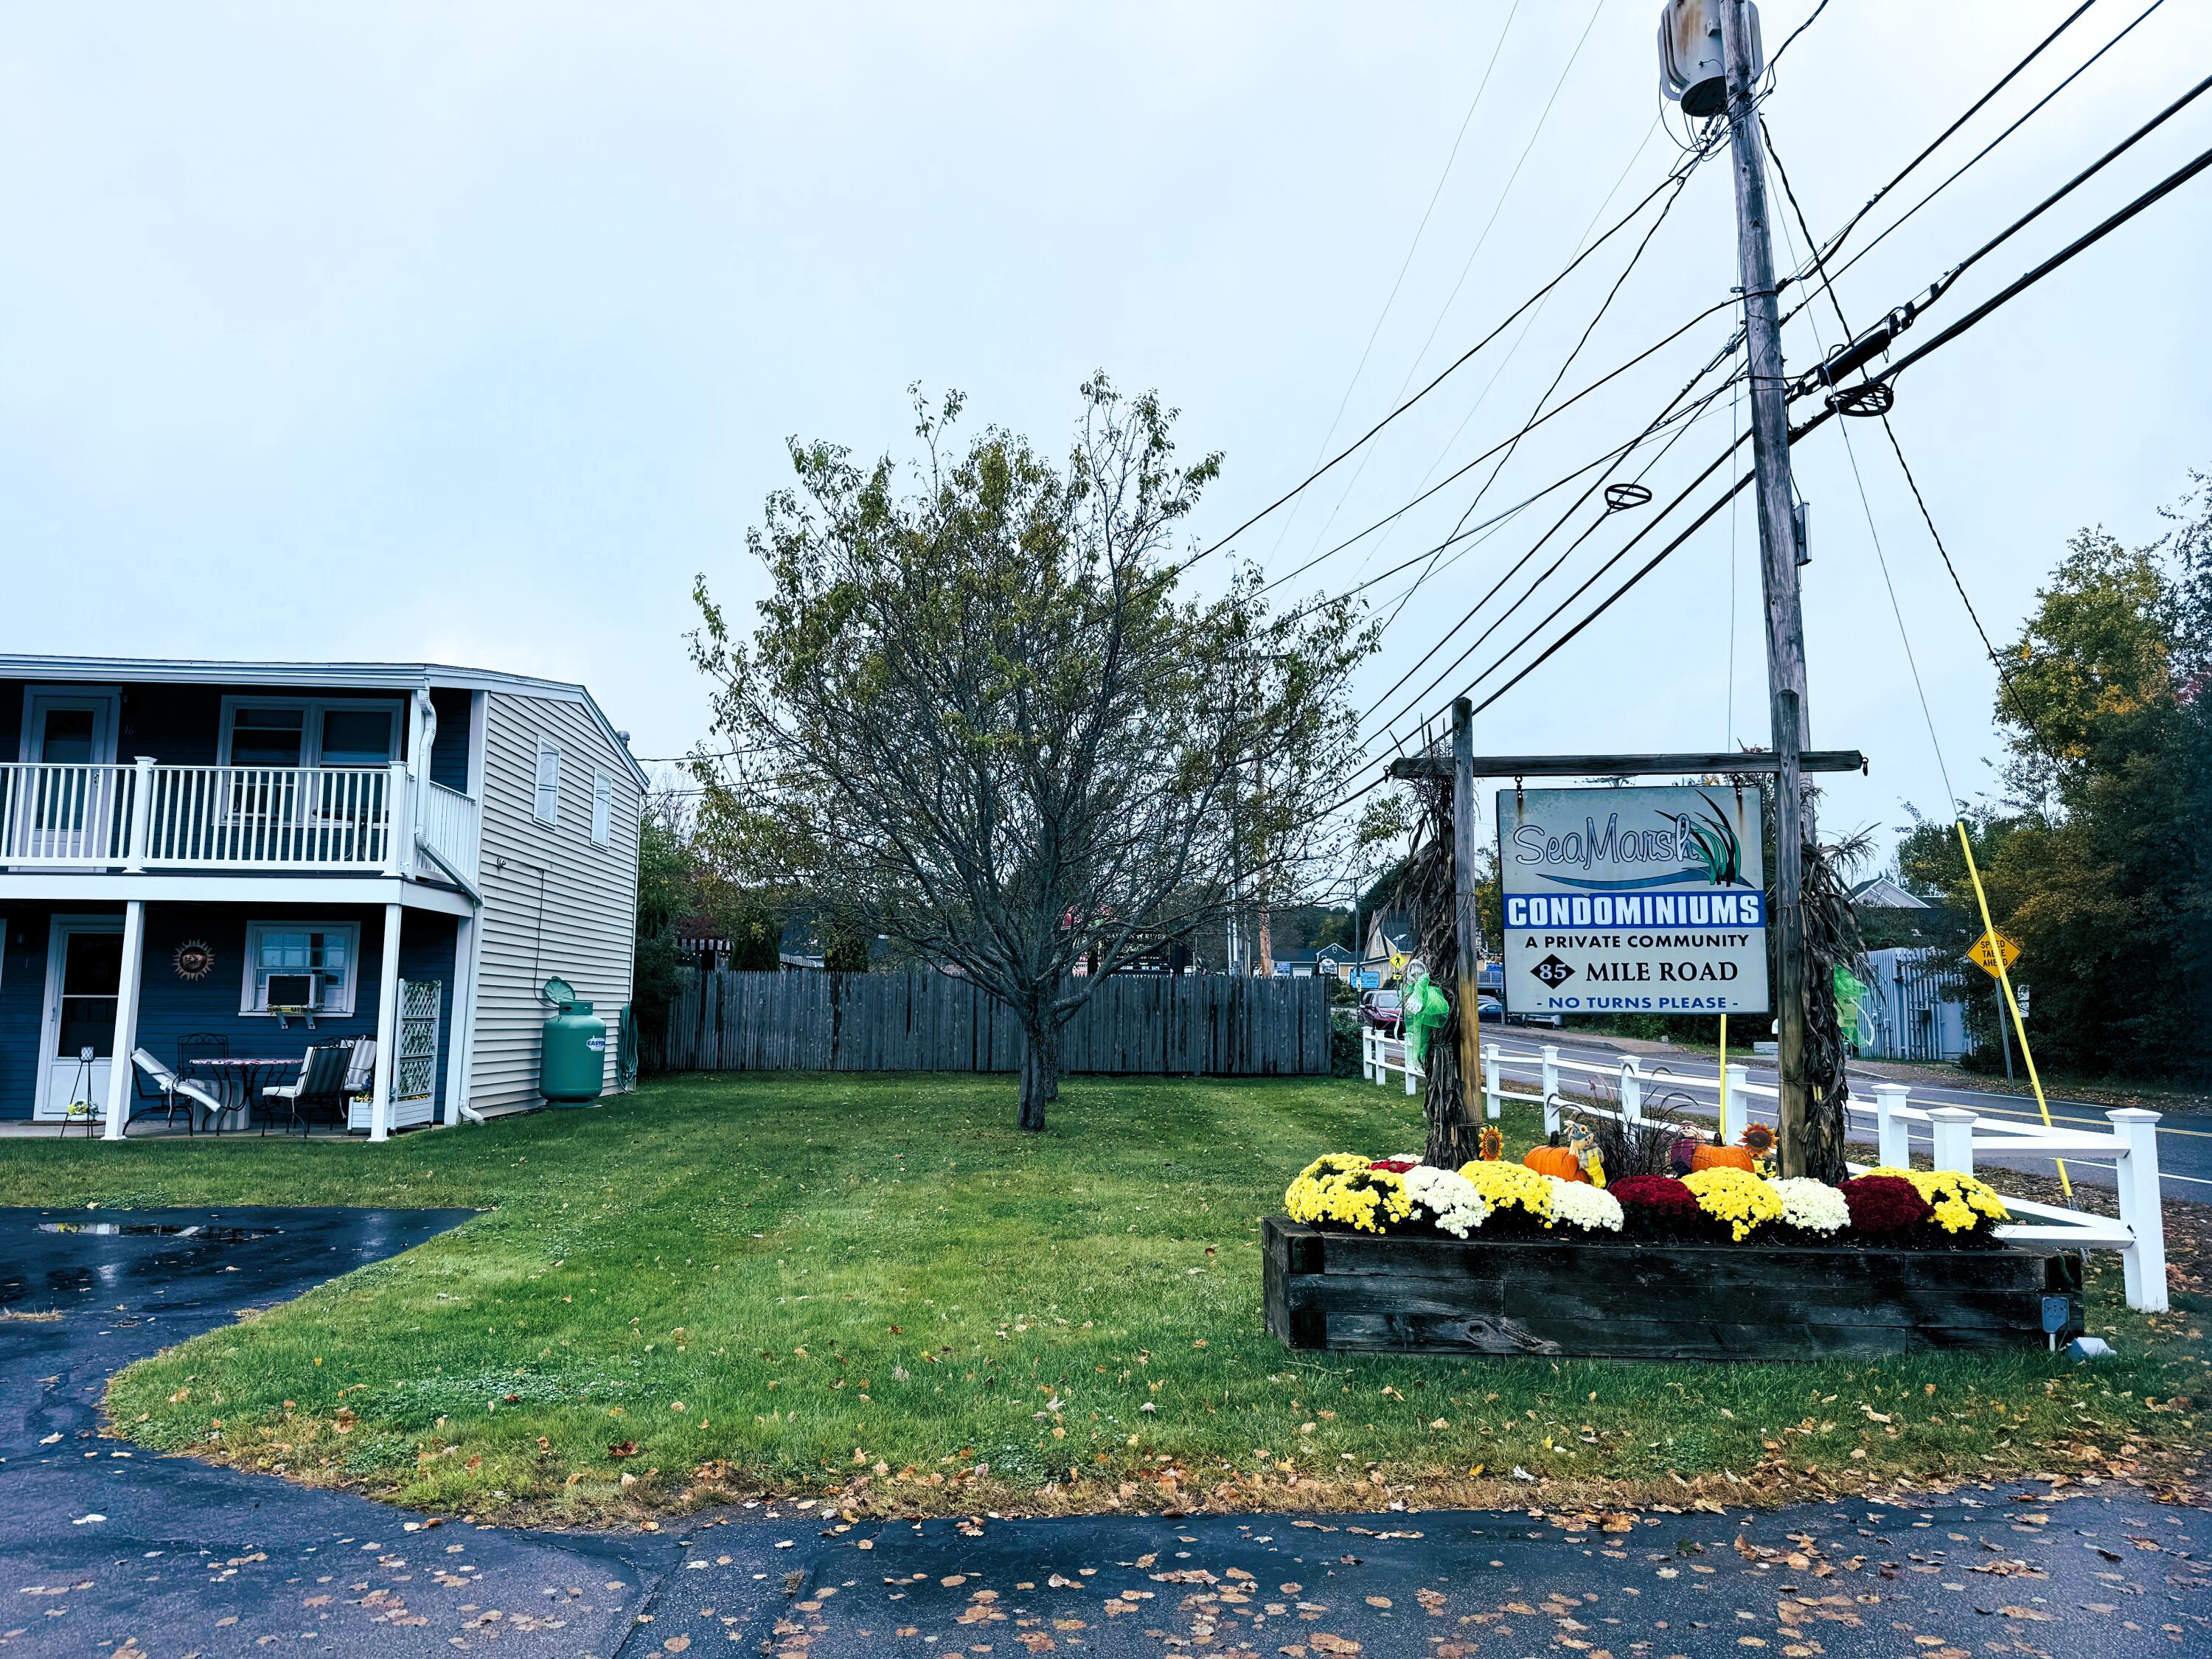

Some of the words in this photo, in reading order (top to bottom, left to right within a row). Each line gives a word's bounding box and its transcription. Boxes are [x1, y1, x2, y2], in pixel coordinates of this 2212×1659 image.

[1508, 894, 1759, 926] CONDOMINIUMS
[1525, 936, 1538, 948] A
[1545, 936, 1621, 948] PRIVATE
[1627, 934, 1750, 947] COMMUNITY
[1980, 940, 2005, 948] SPED
[1983, 959, 2008, 967] AHED
[1539, 964, 1567, 980] 85
[1585, 962, 1651, 981] MILE
[1660, 961, 1738, 981] ROAD
[1549, 997, 1580, 1009] NO
[1586, 997, 1652, 1009] TURNS
[1660, 997, 1727, 1009] PLEASE
